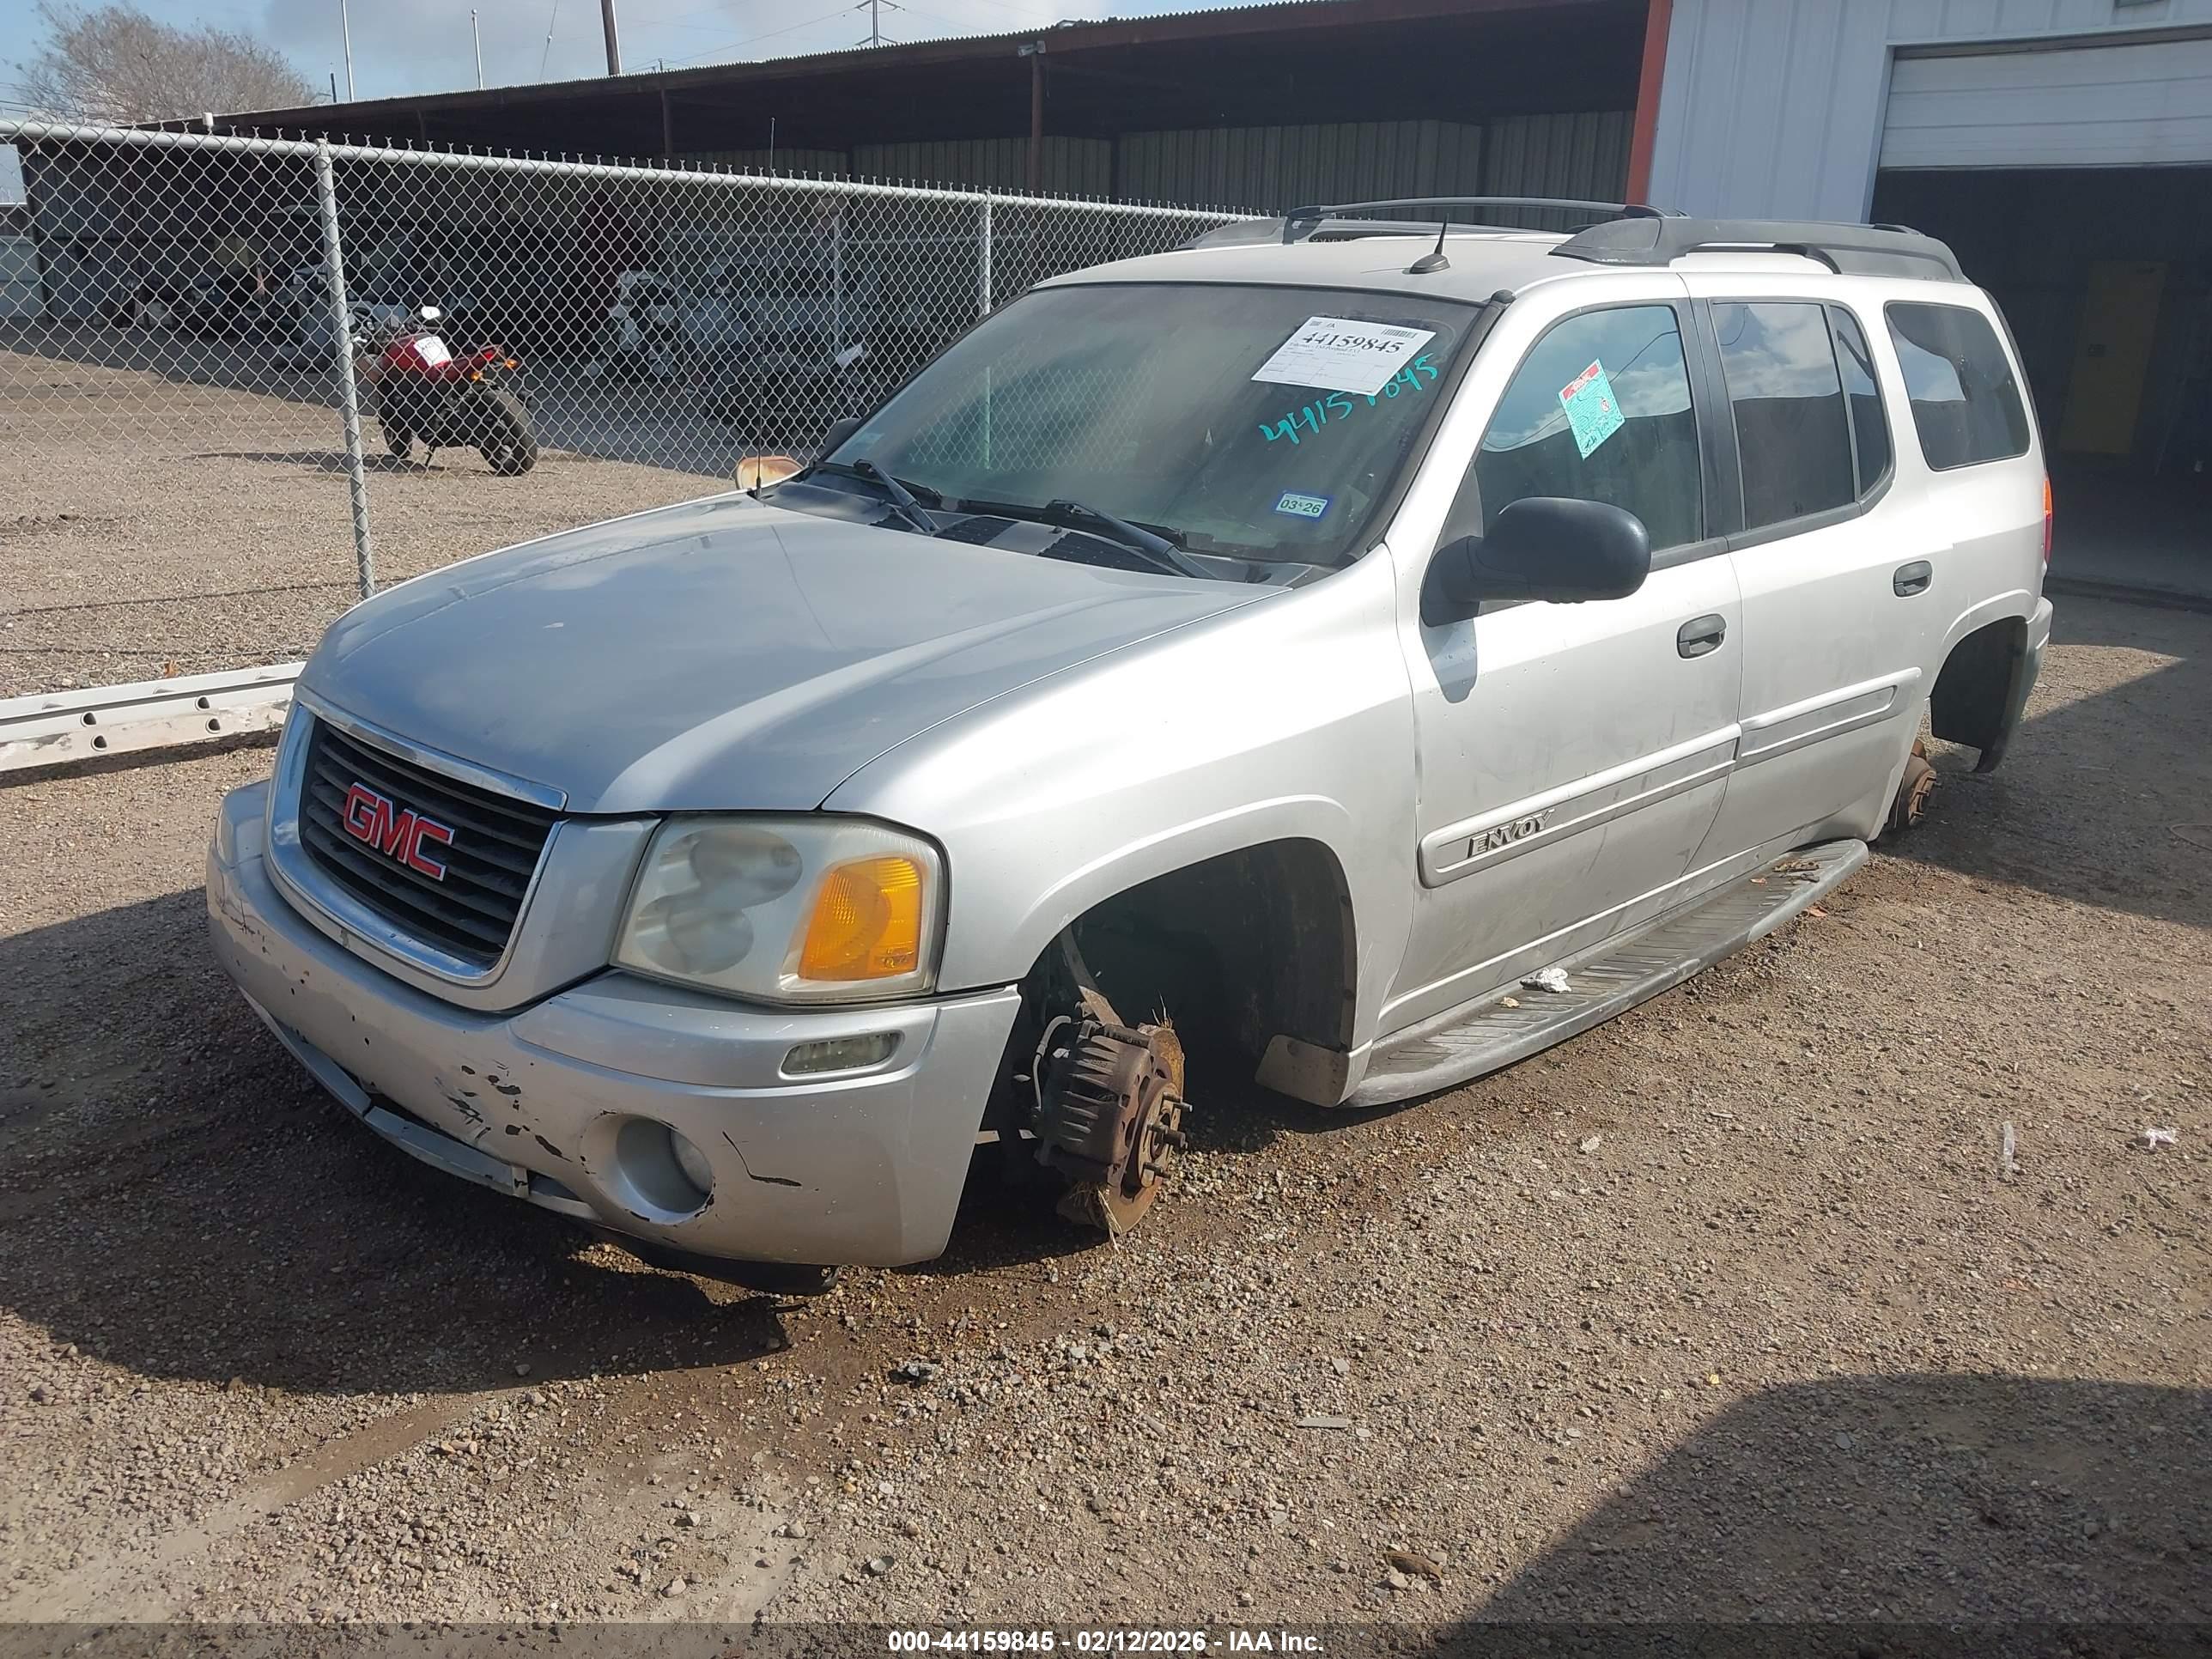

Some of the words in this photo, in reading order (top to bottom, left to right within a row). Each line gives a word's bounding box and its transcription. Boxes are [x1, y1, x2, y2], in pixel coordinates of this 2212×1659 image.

[1302, 331, 1405, 354] 44159845
[1258, 352, 1438, 445] 441545
[1279, 499, 1298, 510] 03
[1302, 502, 1322, 514] 26
[343, 781, 455, 882] GMC
[1465, 808, 1555, 859] ENVOY
